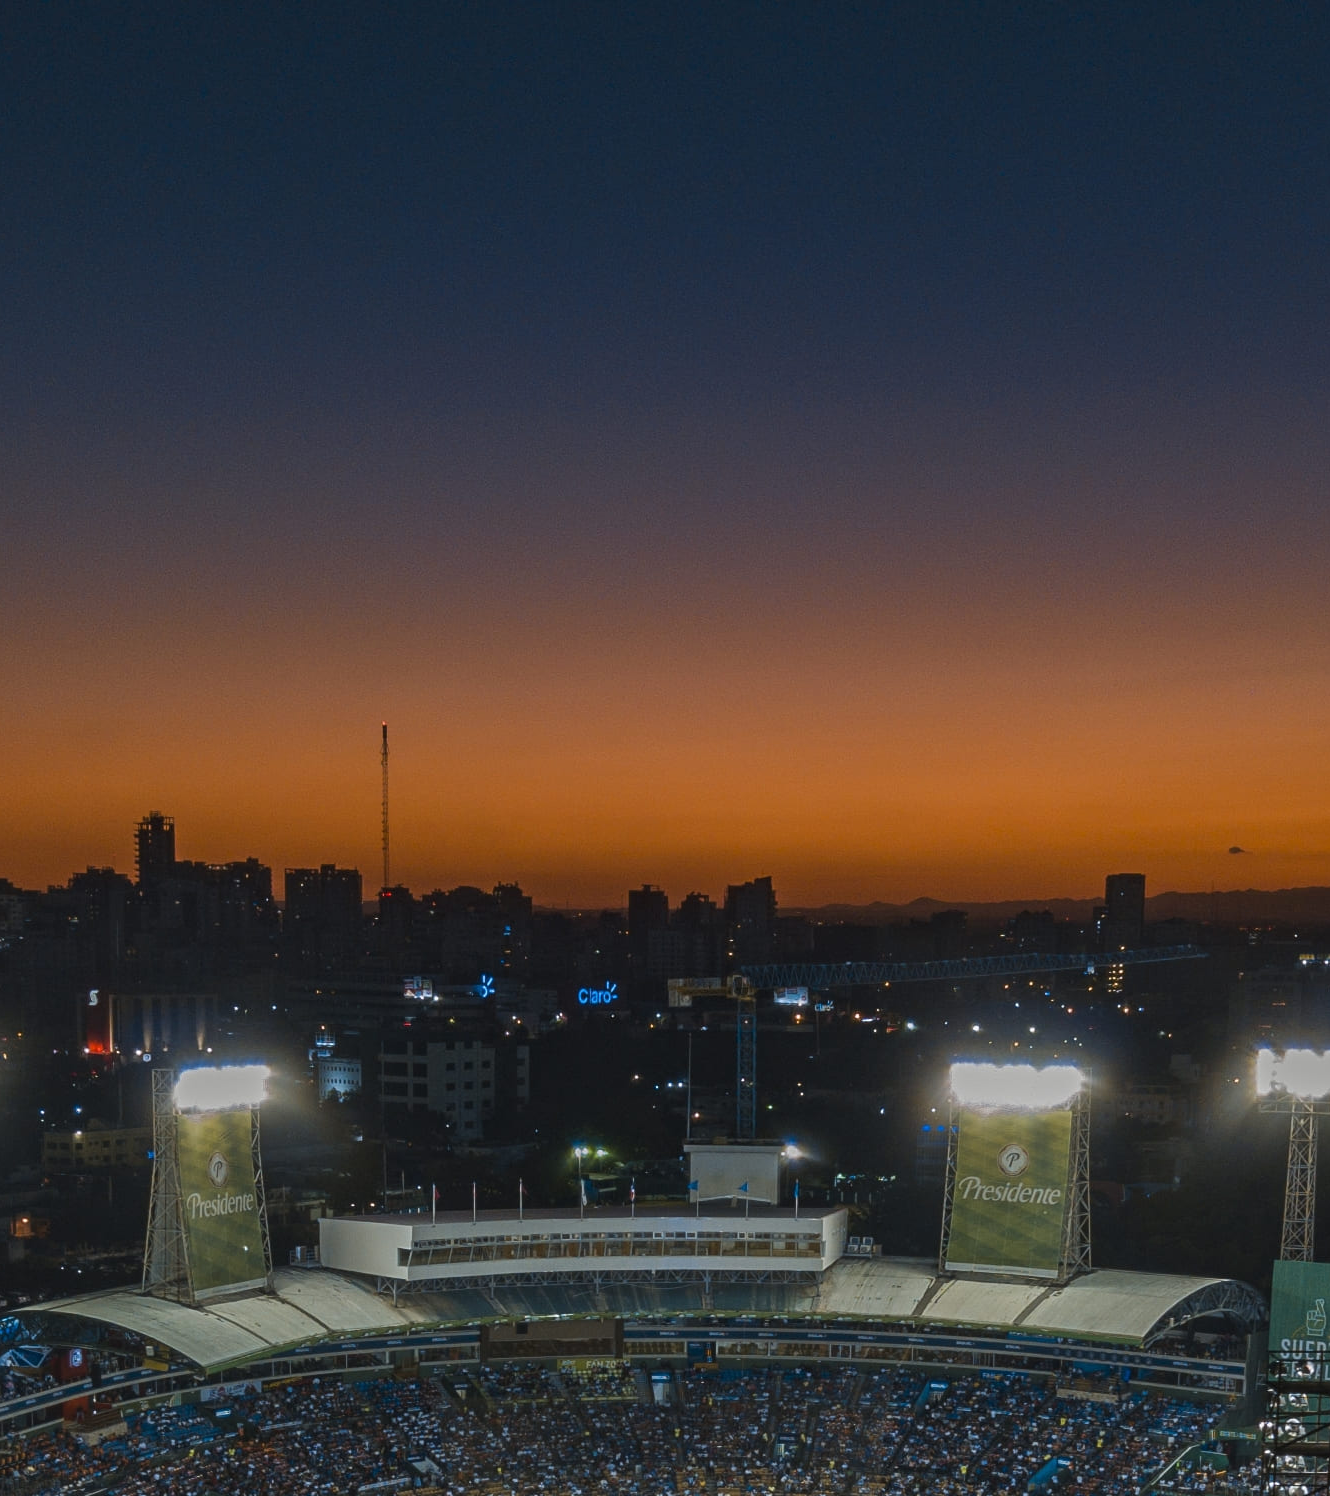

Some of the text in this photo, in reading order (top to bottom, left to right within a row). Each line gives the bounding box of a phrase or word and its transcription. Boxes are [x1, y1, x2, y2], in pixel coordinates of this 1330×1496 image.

[577, 986, 612, 1005] Claro
[958, 1176, 1061, 1205] Presidente
[186, 1192, 254, 1220] Presidente
